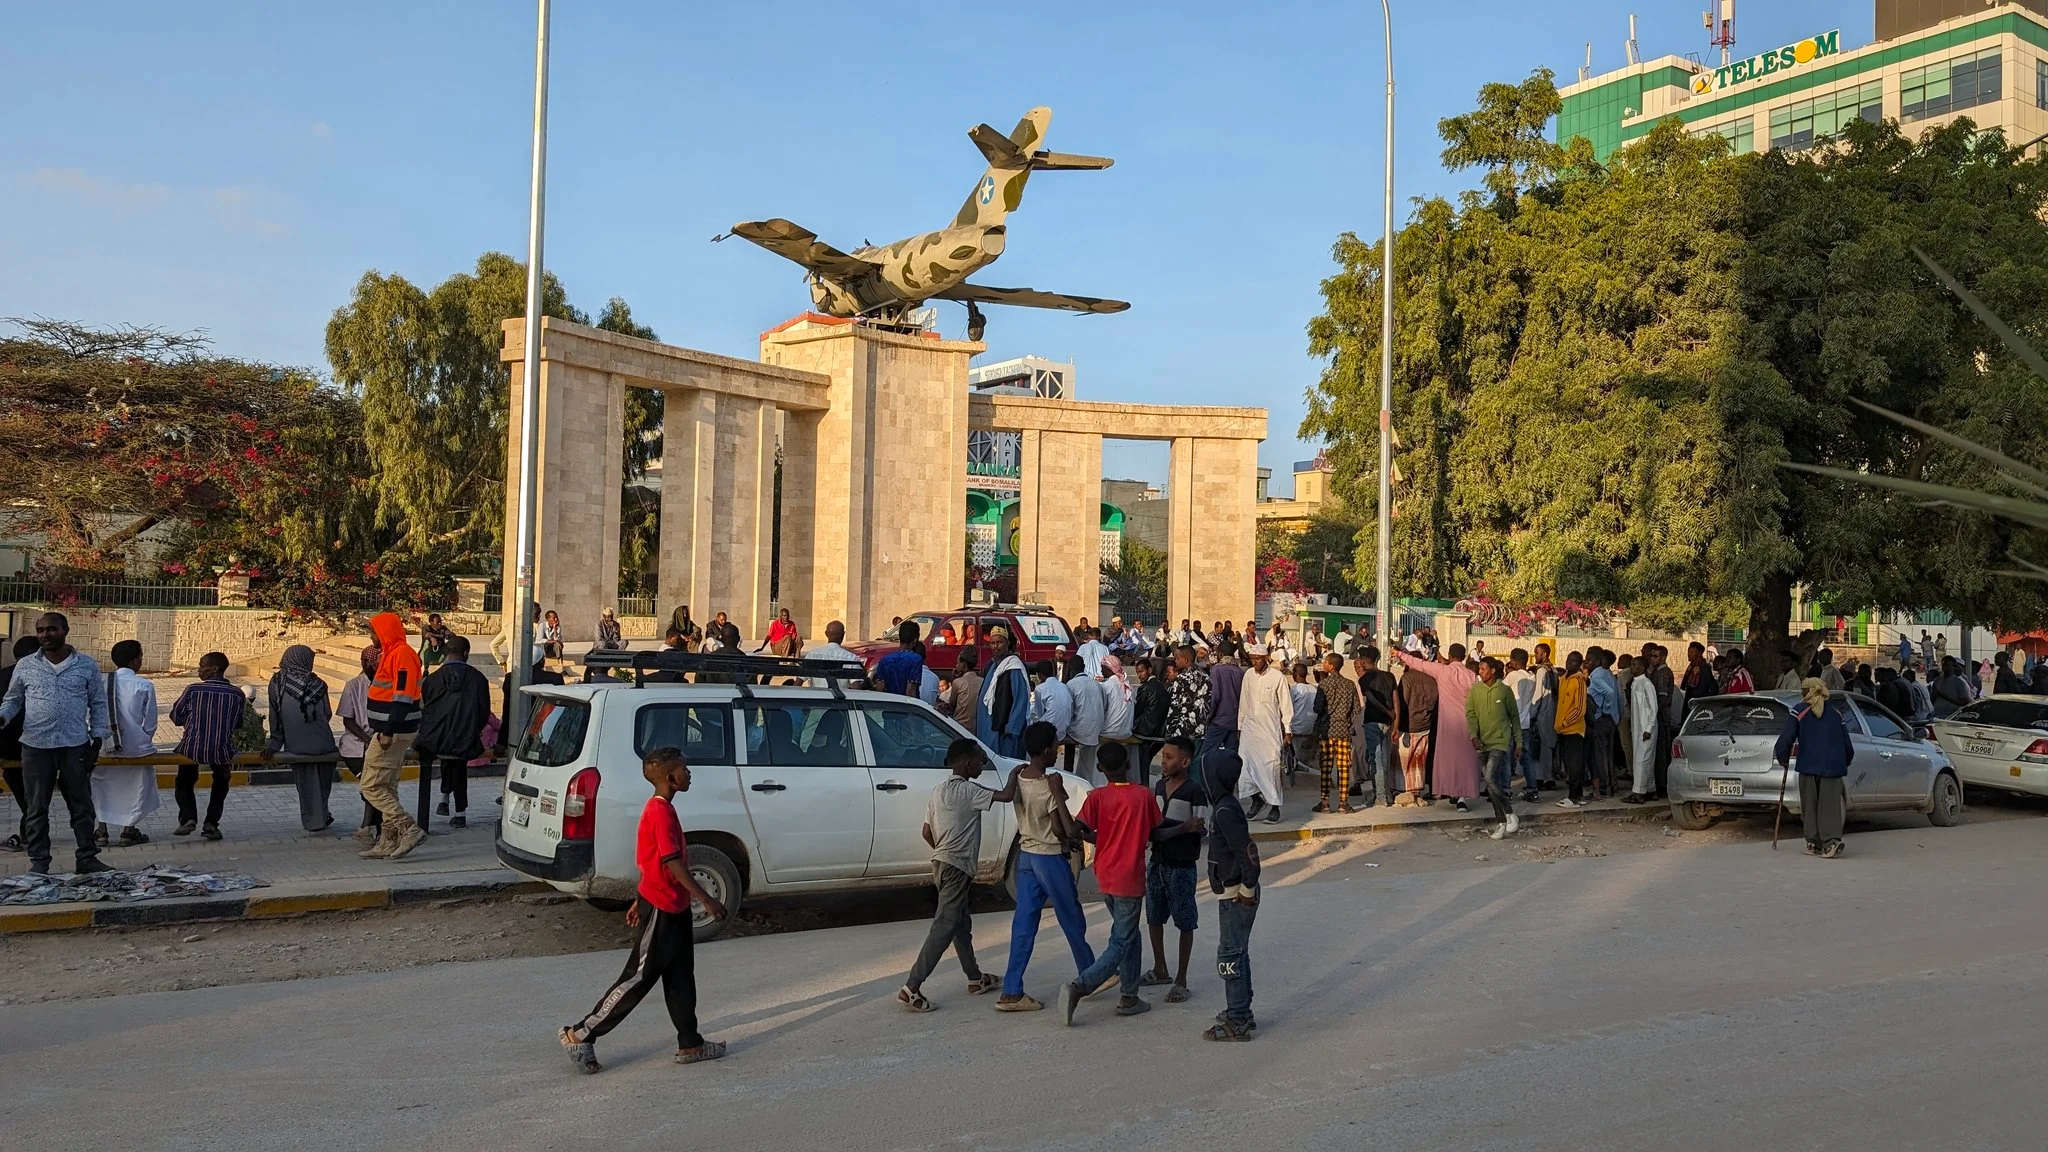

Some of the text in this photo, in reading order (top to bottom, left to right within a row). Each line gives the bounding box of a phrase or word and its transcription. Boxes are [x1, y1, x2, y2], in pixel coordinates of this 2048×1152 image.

[1714, 30, 1839, 89] TELESOM
[1720, 785, 1741, 794] B1498
[1218, 962, 1236, 975] CK
